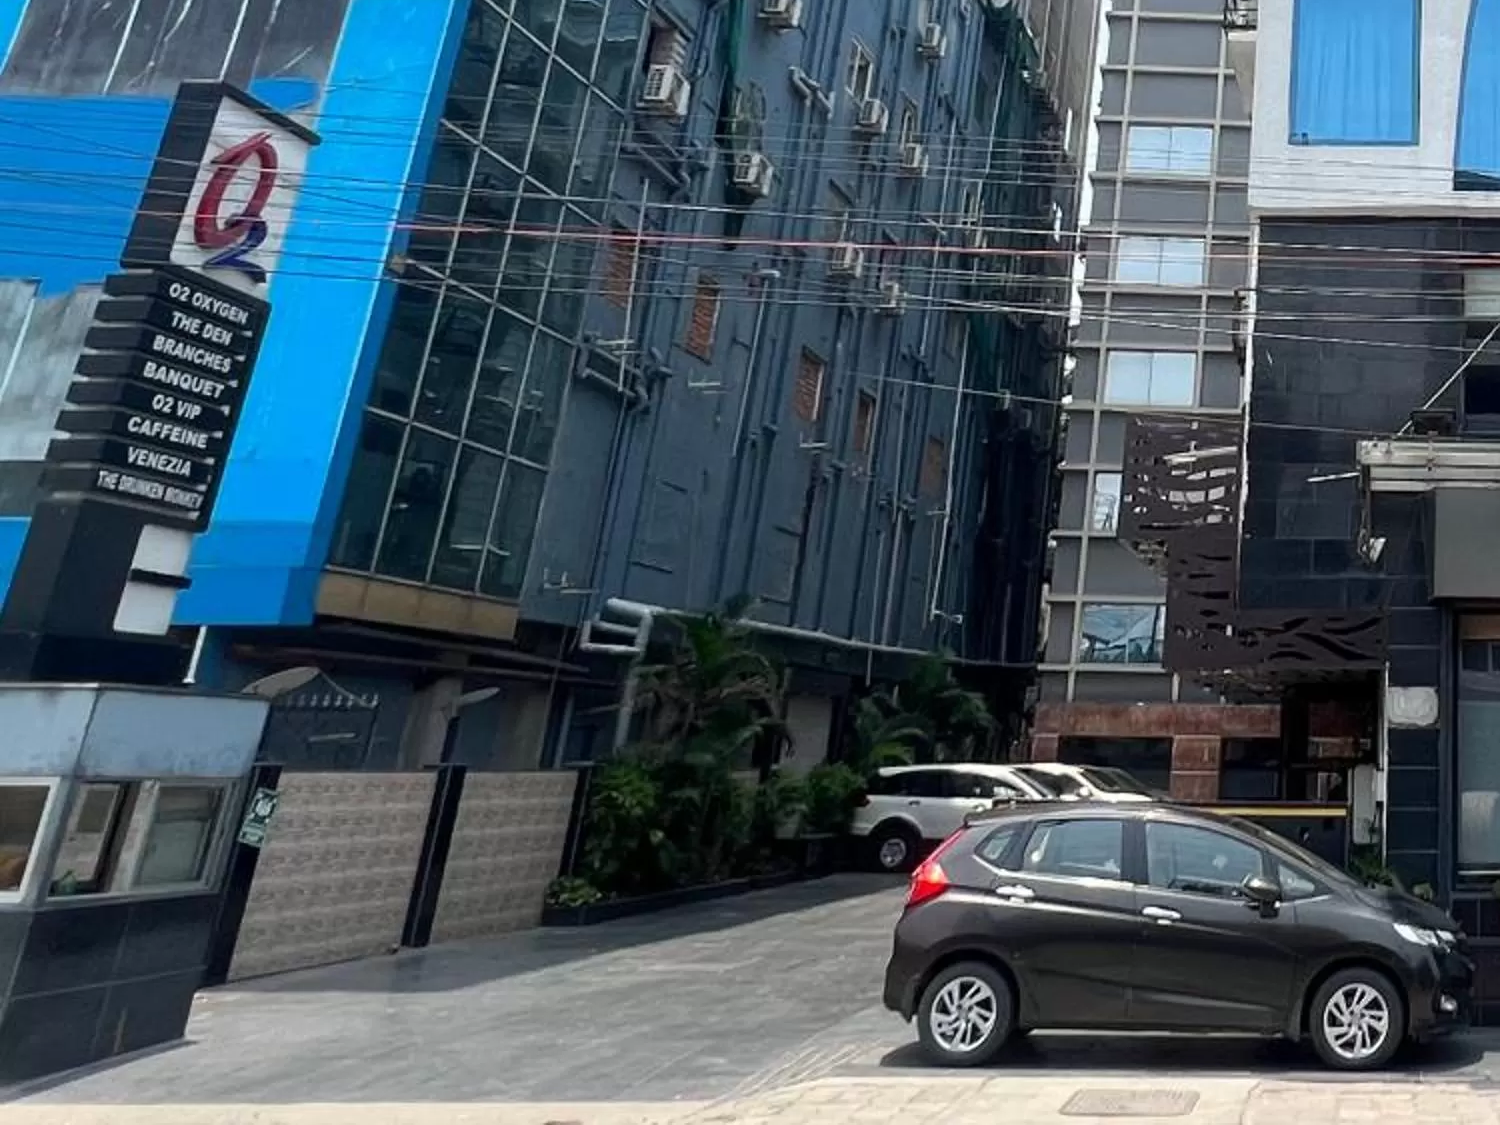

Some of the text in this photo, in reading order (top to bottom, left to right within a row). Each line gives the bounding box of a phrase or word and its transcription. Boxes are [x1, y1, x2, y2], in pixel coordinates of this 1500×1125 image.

[192, 292, 249, 324] OXYGEN
[171, 311, 233, 347] THE DEN
[153, 334, 232, 374] BRANCHES
[143, 361, 225, 399] BANQUET
[177, 401, 202, 420] VIP
[128, 416, 208, 449] CAFFEINE
[127, 446, 192, 477] VENEZIA
[97, 470, 119, 490] THE
